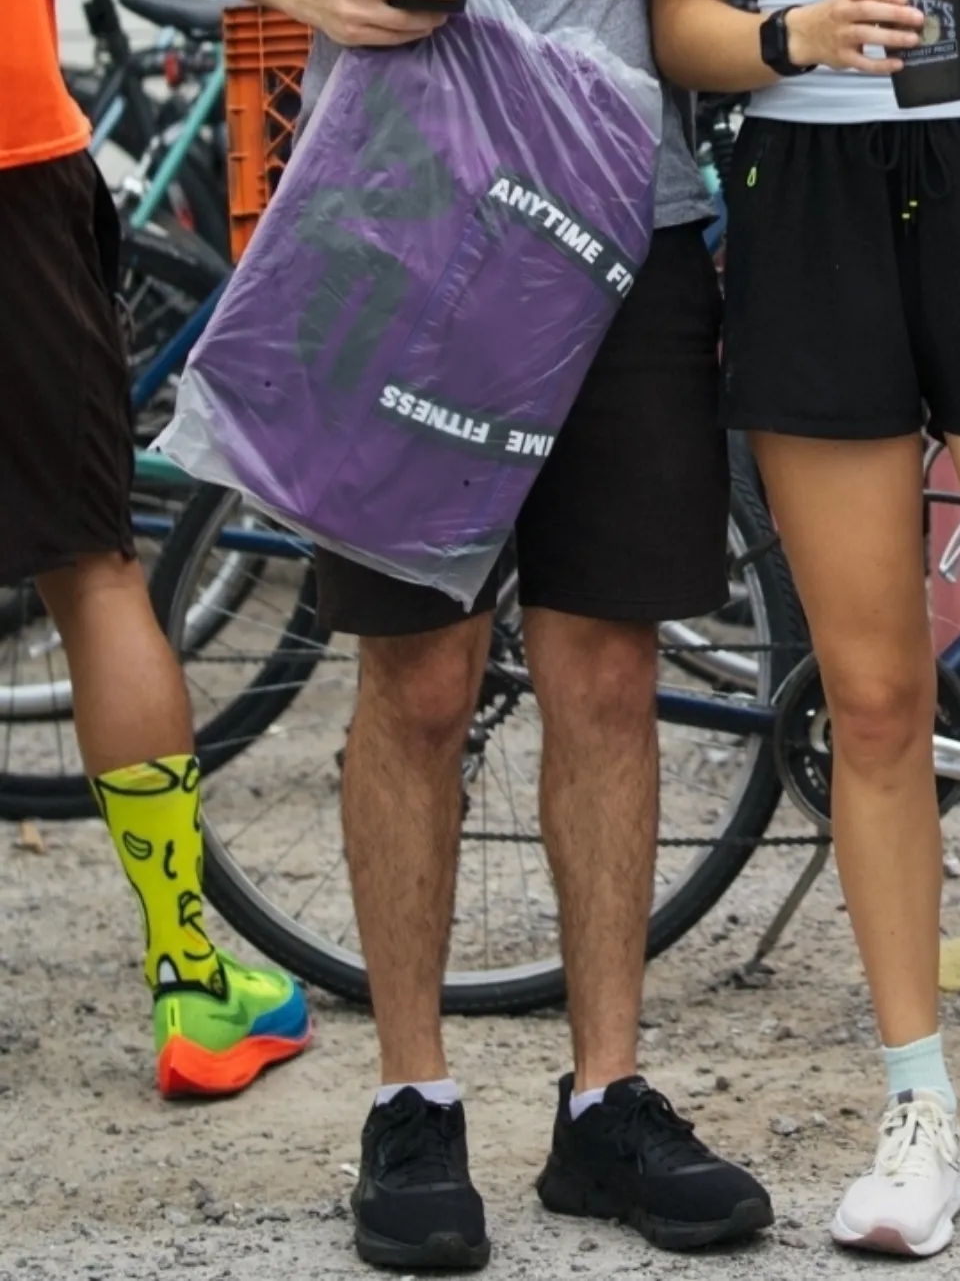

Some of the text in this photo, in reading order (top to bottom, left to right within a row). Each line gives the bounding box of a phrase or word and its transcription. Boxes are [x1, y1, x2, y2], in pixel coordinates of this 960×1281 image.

[488, 177, 603, 264] ANYTIME
[380, 385, 555, 457] IME FITNESS
